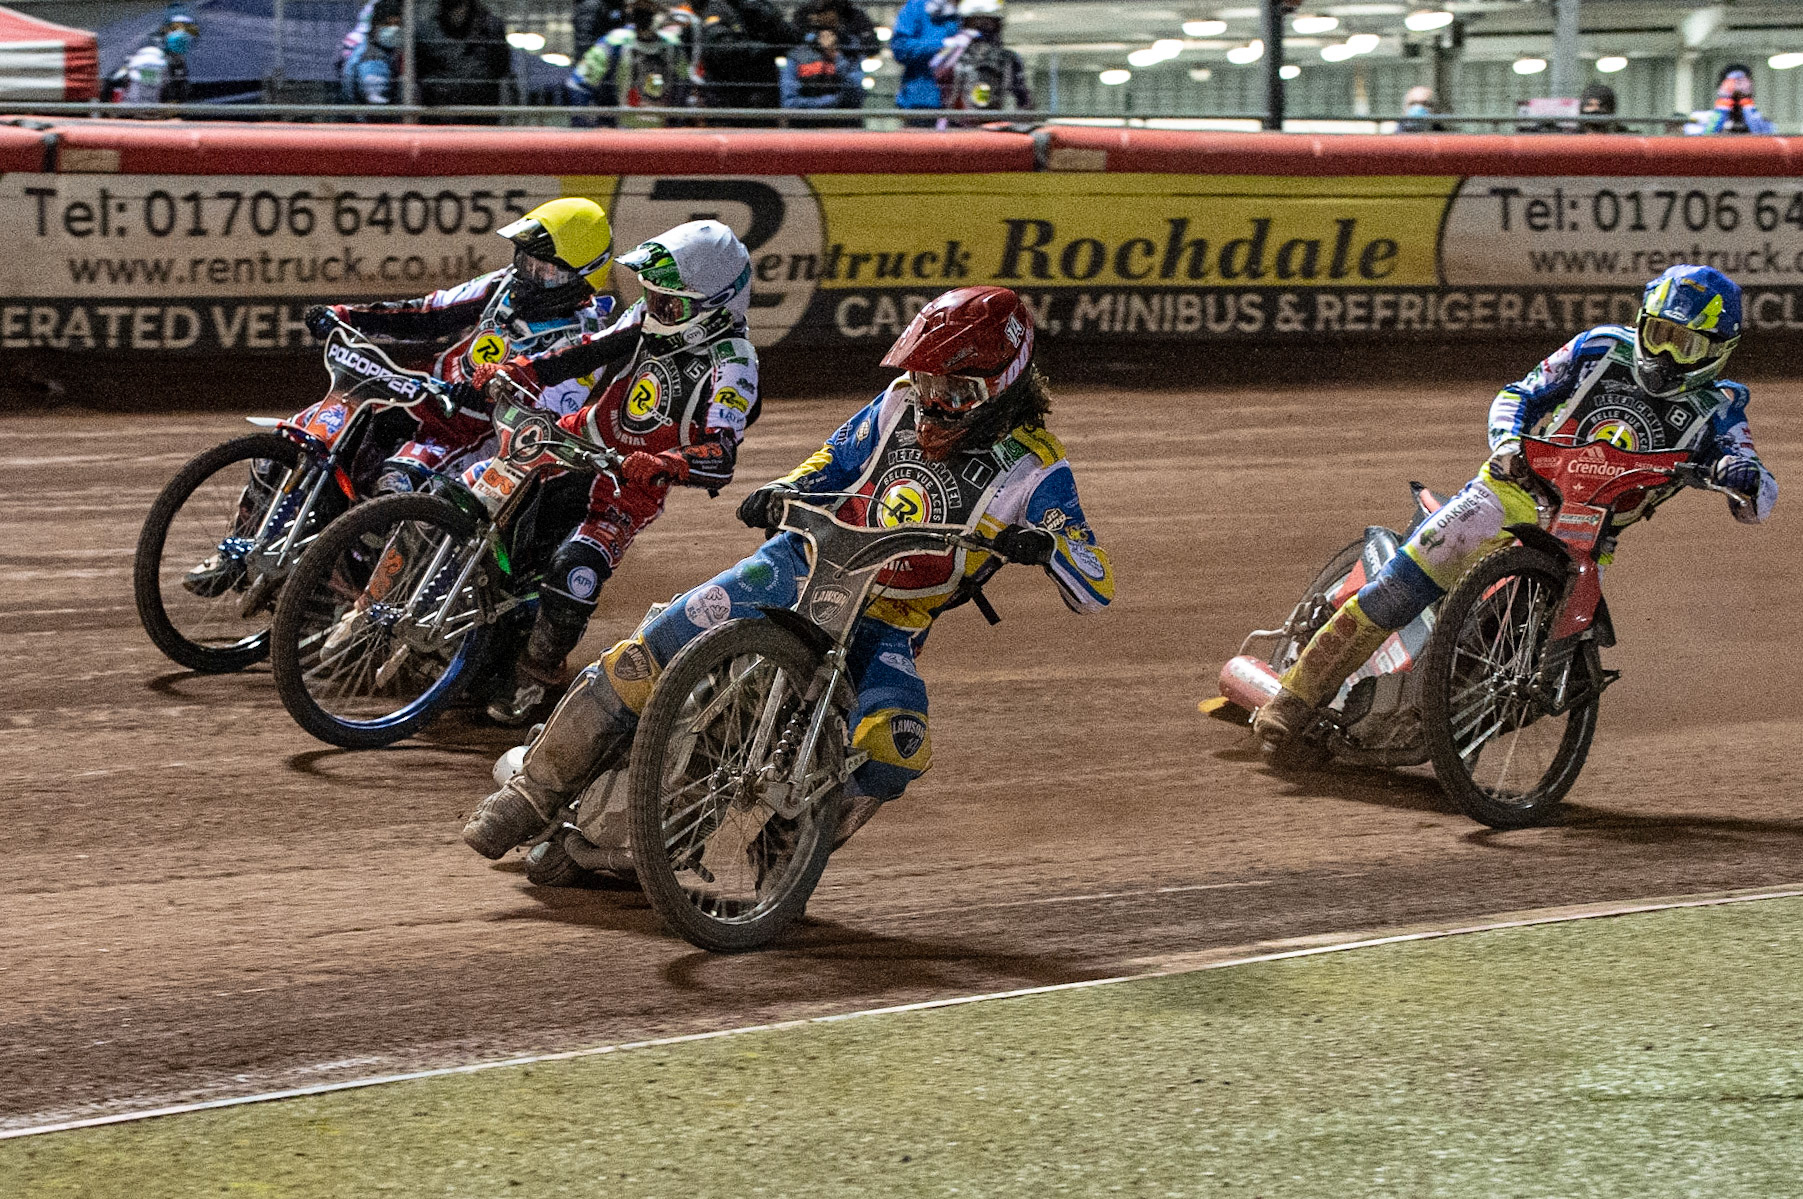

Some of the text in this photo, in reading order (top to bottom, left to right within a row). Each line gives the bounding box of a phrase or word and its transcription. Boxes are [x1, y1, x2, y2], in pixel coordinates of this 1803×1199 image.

[25, 186, 127, 238] Tel:
[144, 188, 315, 238] 01706
[1489, 187, 1579, 232] Tel:
[1592, 188, 1741, 232] 01706
[68, 245, 487, 286] www.rentruck.co.uk
[990, 216, 1399, 282] Rochdale
[1, 305, 201, 350] ERATED
[1072, 294, 1264, 334] MINIBUS
[1273, 293, 1309, 334] &
[1314, 293, 1639, 334] REFRIGERATED
[686, 361, 705, 379] 15
[1590, 410, 1621, 424] BELLE
[1624, 413, 1641, 430] VUE
[1670, 408, 1688, 427] 8
[1567, 459, 1626, 476] Crendon
[883, 469, 942, 521] BELLE VUE ACES
[892, 719, 925, 741] LAWSON
